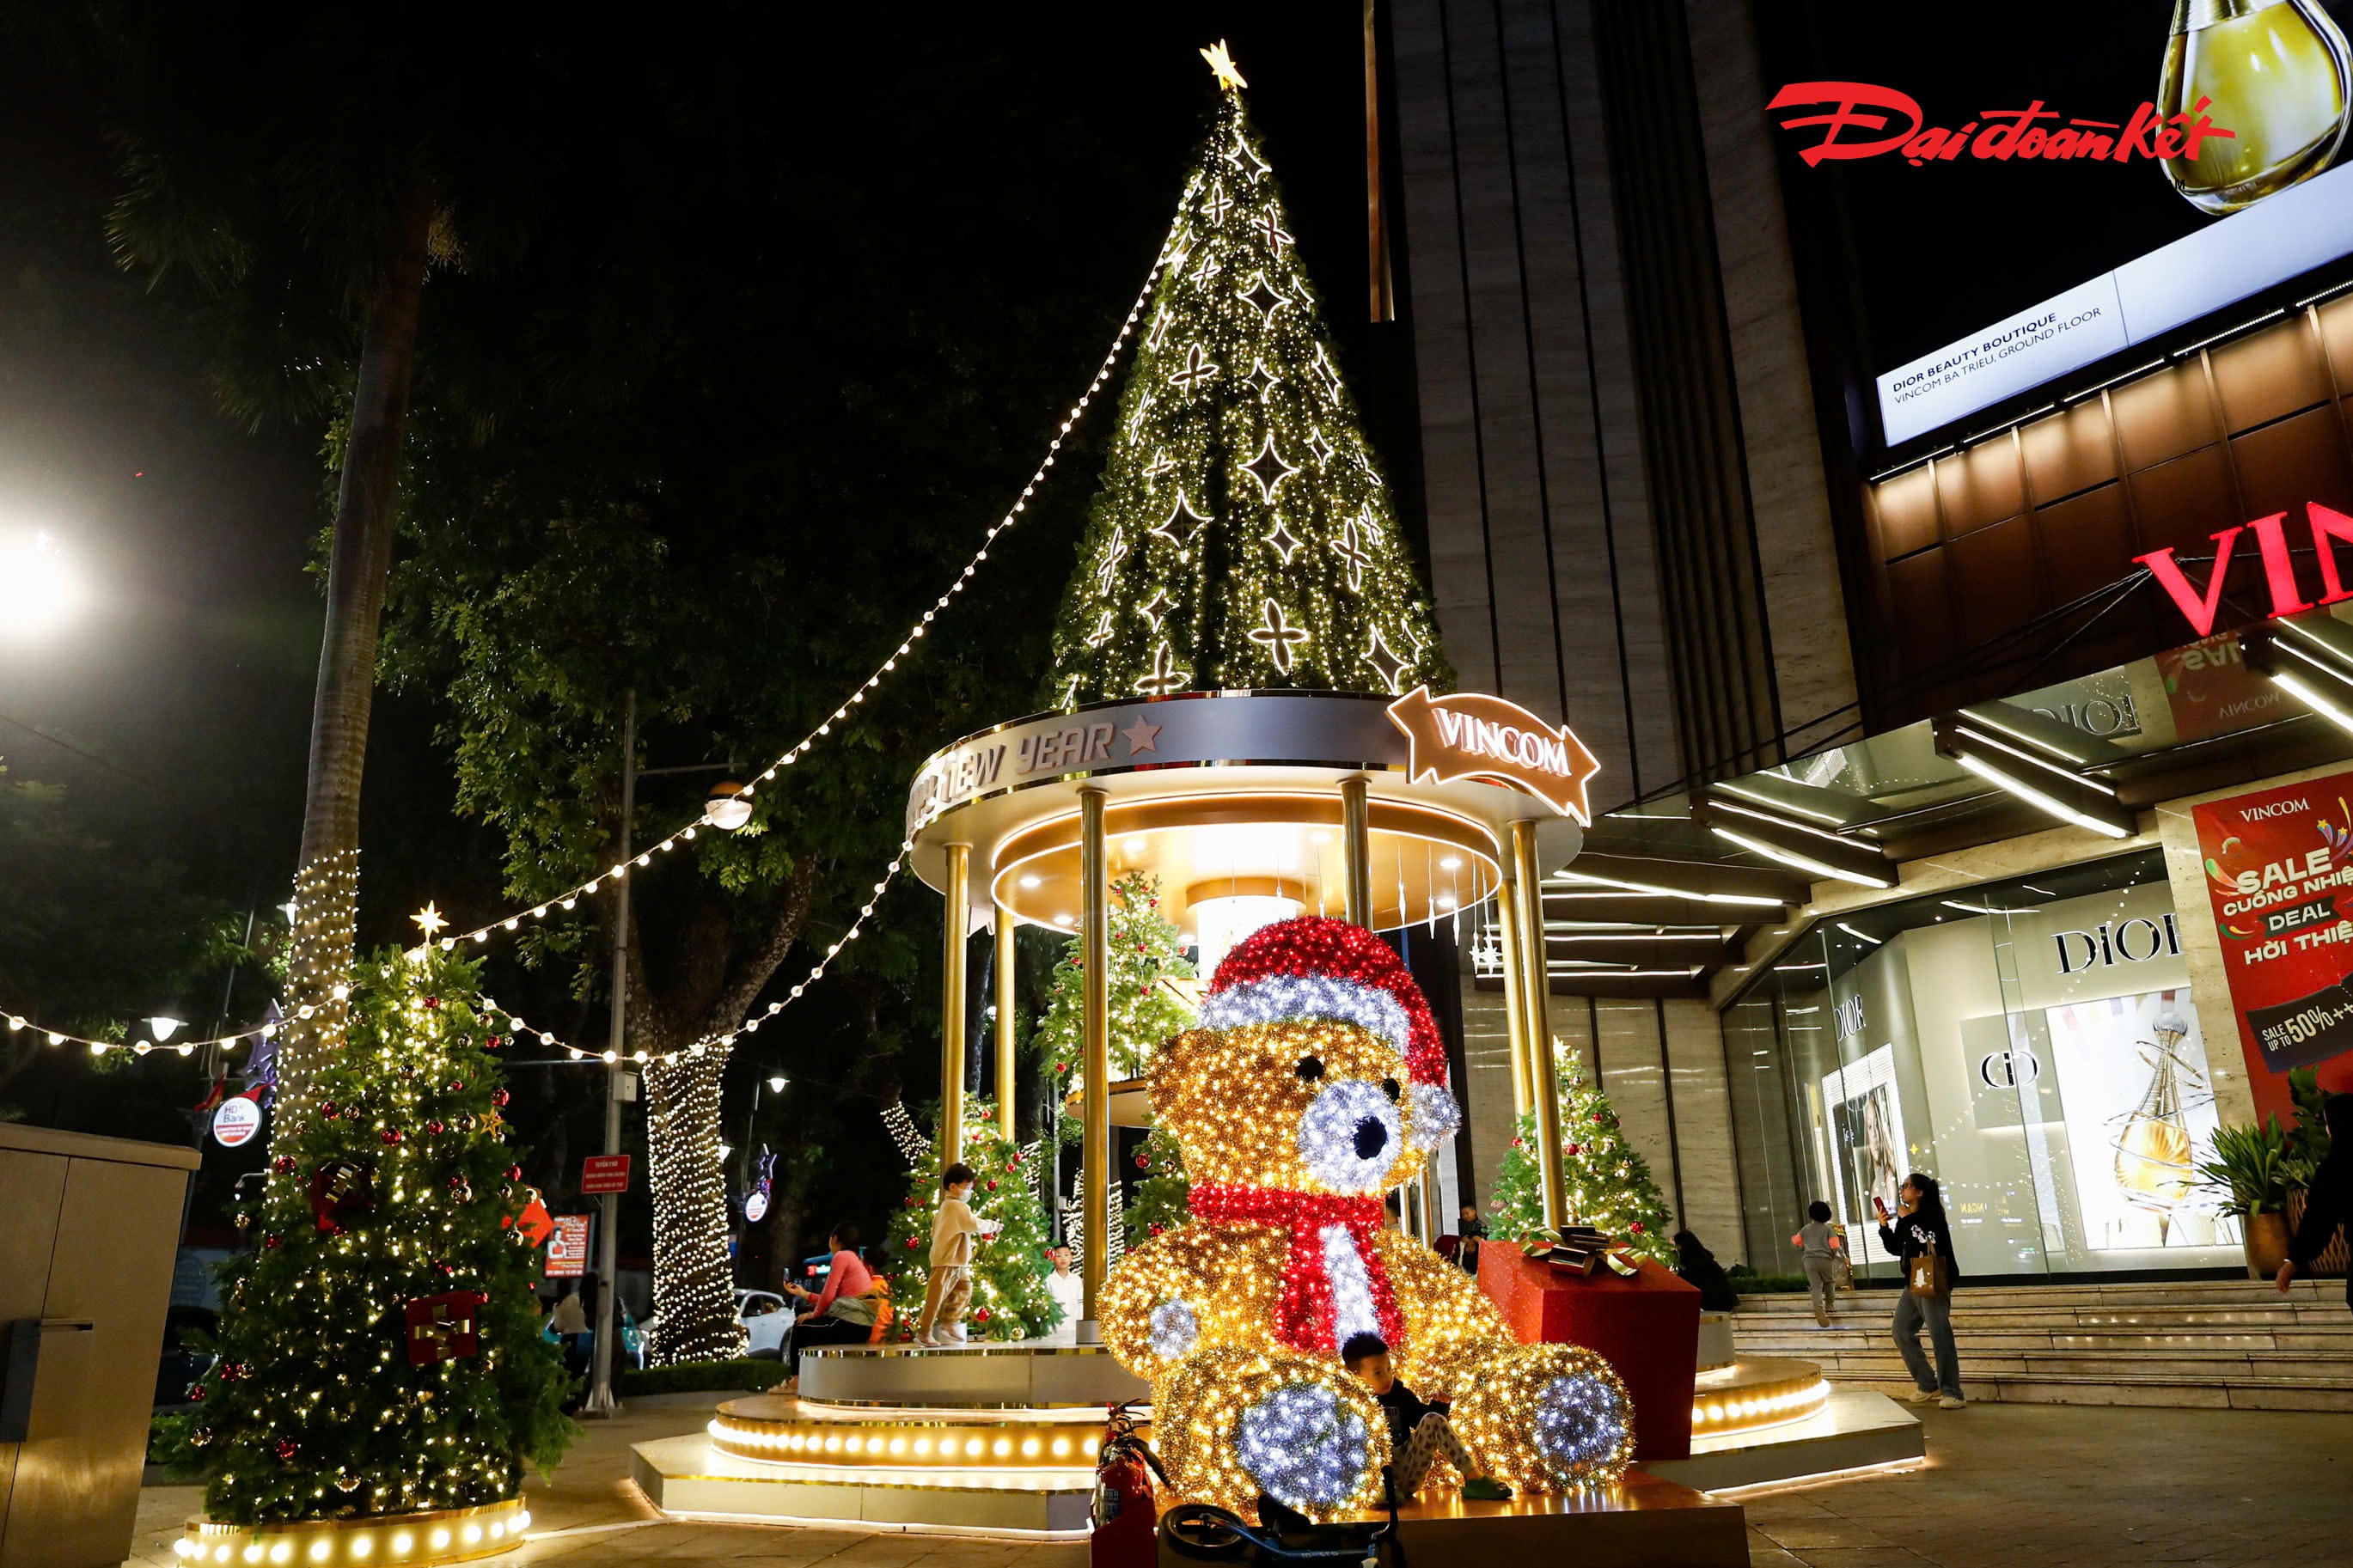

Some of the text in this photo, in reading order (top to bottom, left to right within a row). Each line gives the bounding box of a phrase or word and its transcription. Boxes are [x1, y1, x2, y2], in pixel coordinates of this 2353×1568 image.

[1893, 313, 2057, 393] DIOR BEAUTY BOUTIQUE
[1894, 308, 2102, 404] VINCOM BA TRIEU, GROUND FLOOR
[1015, 722, 1115, 775] YEAR
[1431, 706, 1572, 778] VINCOM
[2240, 797, 2310, 822] VINCOM
[2236, 847, 2332, 894] SALE
[2268, 902, 2331, 931] DEAL
[2244, 940, 2288, 965] HỜI
[1833, 993, 1867, 1041] DIOR
[2262, 1023, 2286, 1041] SALE
[2268, 1034, 2292, 1052] UP TO
[223, 1114, 246, 1123] Bank
[225, 1105, 238, 1113] HD
